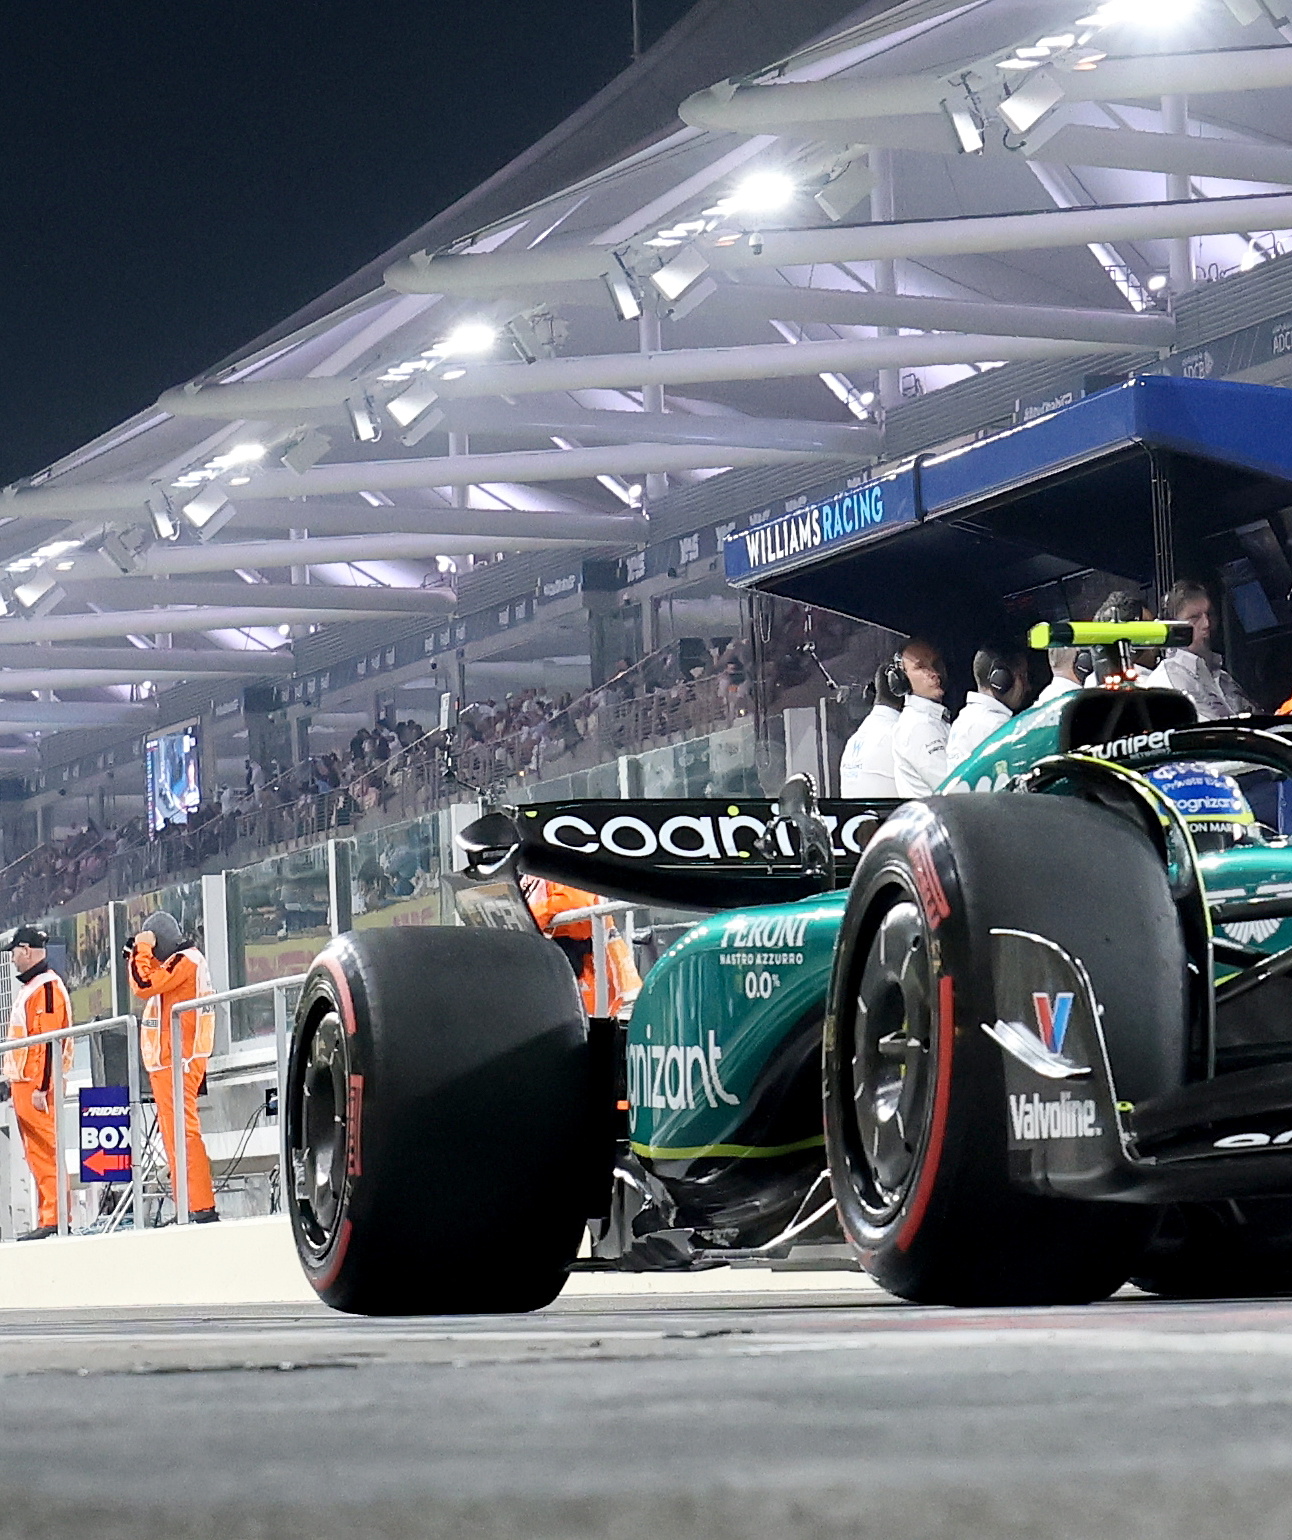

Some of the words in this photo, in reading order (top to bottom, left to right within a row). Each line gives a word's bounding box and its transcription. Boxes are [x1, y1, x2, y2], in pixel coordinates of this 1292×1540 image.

[745, 509, 821, 569] WILLIAMS
[822, 485, 884, 542] RACING
[1174, 796, 1241, 813] ognizan
[720, 915, 809, 949] PERONI
[720, 953, 754, 965] NASTRO
[755, 953, 804, 965] AZZURRO
[626, 1024, 741, 1135] gnizant
